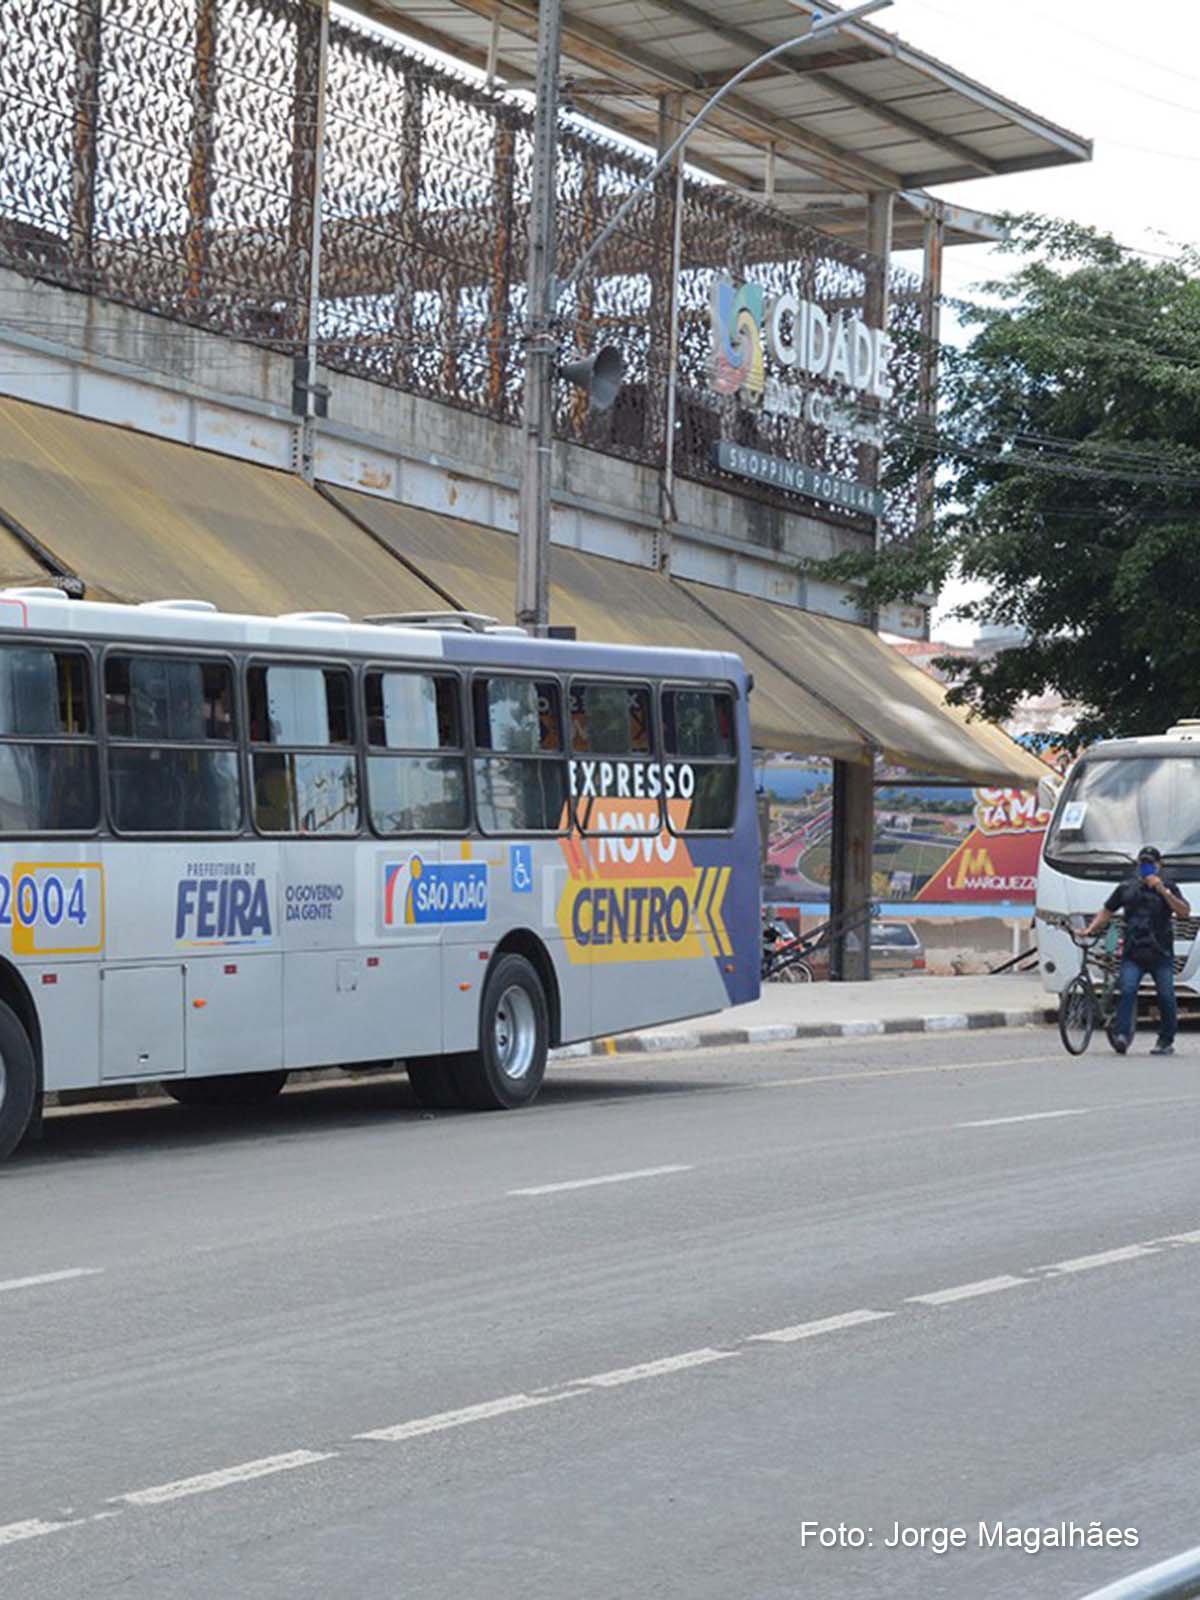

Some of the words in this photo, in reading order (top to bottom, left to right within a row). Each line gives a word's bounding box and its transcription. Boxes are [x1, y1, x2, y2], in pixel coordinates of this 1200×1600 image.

[773, 292, 894, 399] CIDADE
[729, 447, 805, 489] SHOPPING
[813, 475, 874, 511] POPULAR
[568, 760, 694, 799] EXPRESSO
[597, 811, 677, 864] NOVO
[187, 862, 241, 877] PREFEITURA
[244, 862, 256, 876] DE
[285, 885, 295, 901] O
[295, 884, 344, 901] GOVERNO
[417, 874, 448, 911] SÃO
[450, 873, 487, 909] JOÃO
[175, 878, 272, 939] FEIRA
[286, 905, 300, 921] DA
[302, 904, 333, 920] GENTE
[572, 885, 690, 946] CENTRO
